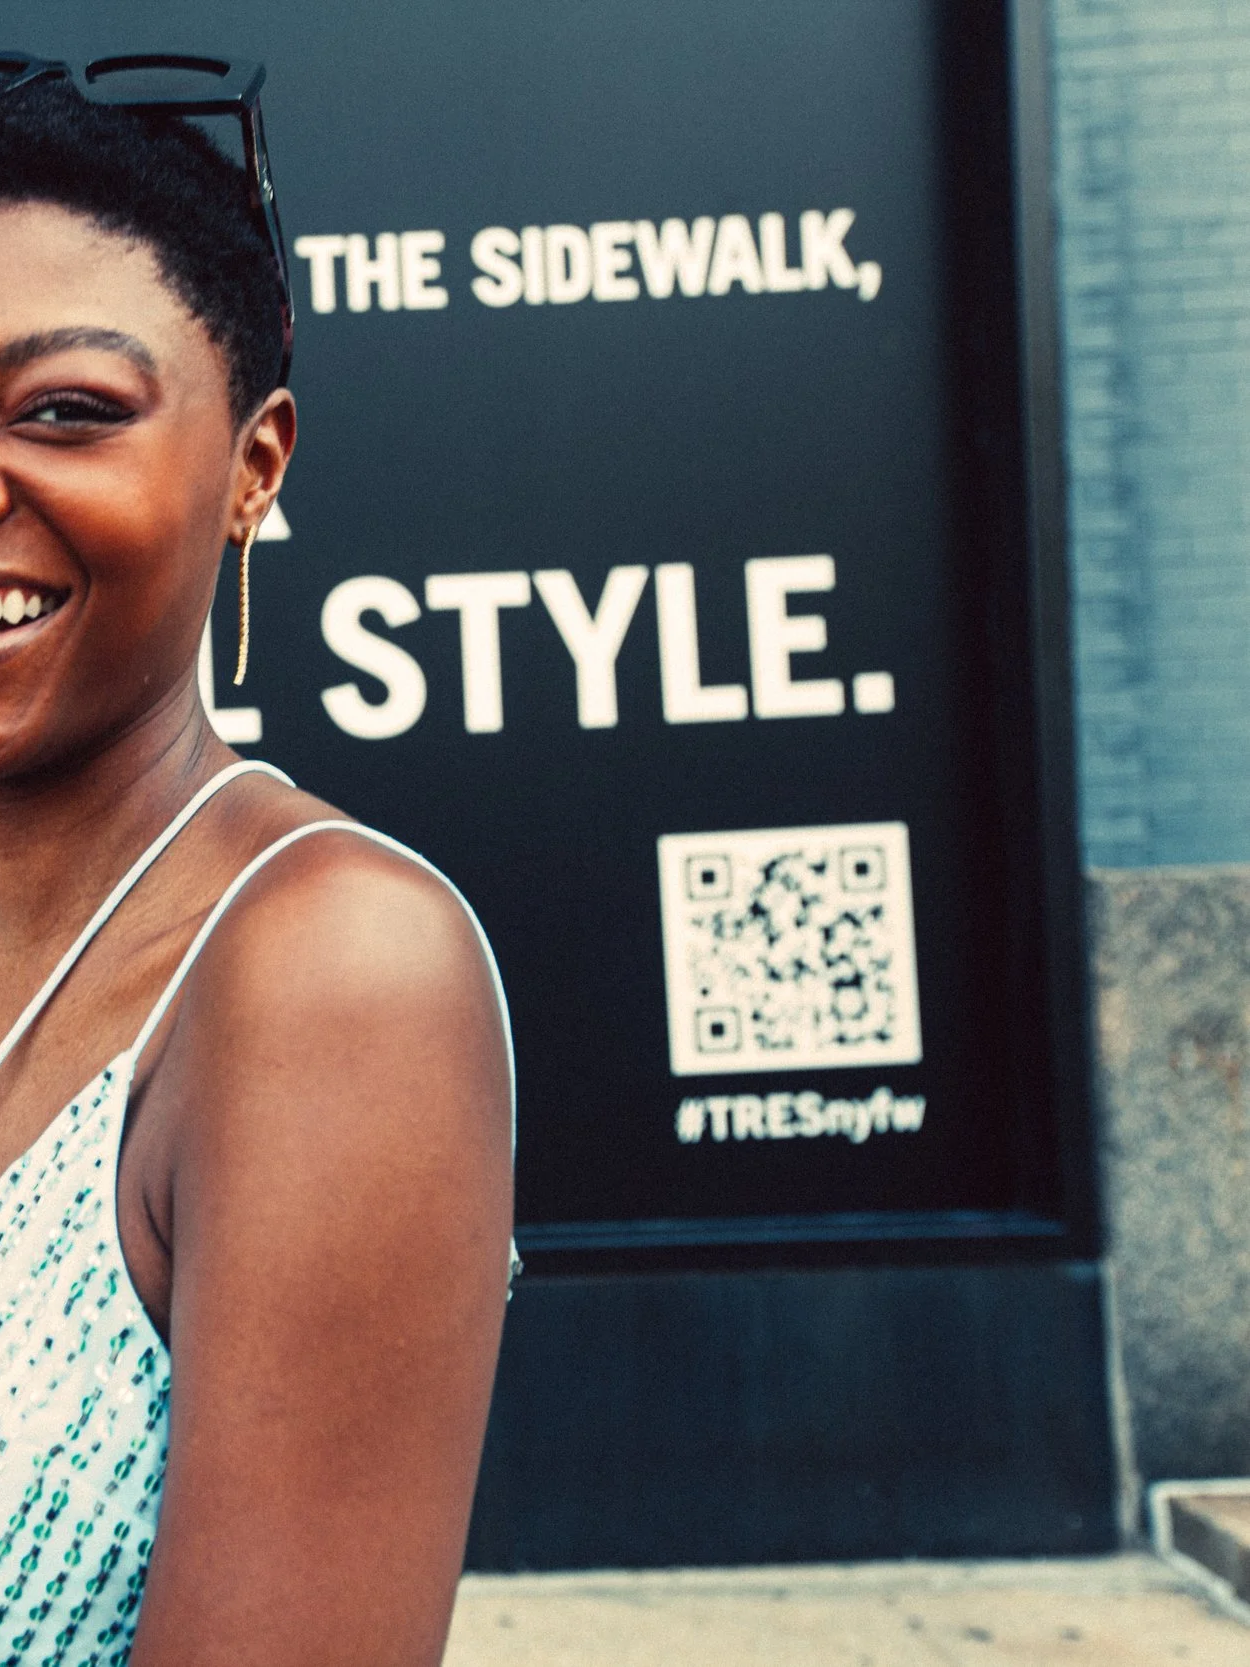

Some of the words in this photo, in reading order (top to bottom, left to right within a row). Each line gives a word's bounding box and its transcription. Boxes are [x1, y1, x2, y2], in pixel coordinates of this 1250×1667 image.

[294, 231, 449, 314] THE
[470, 207, 882, 308] SIDEWALK,
[321, 554, 895, 740] STYLE.
